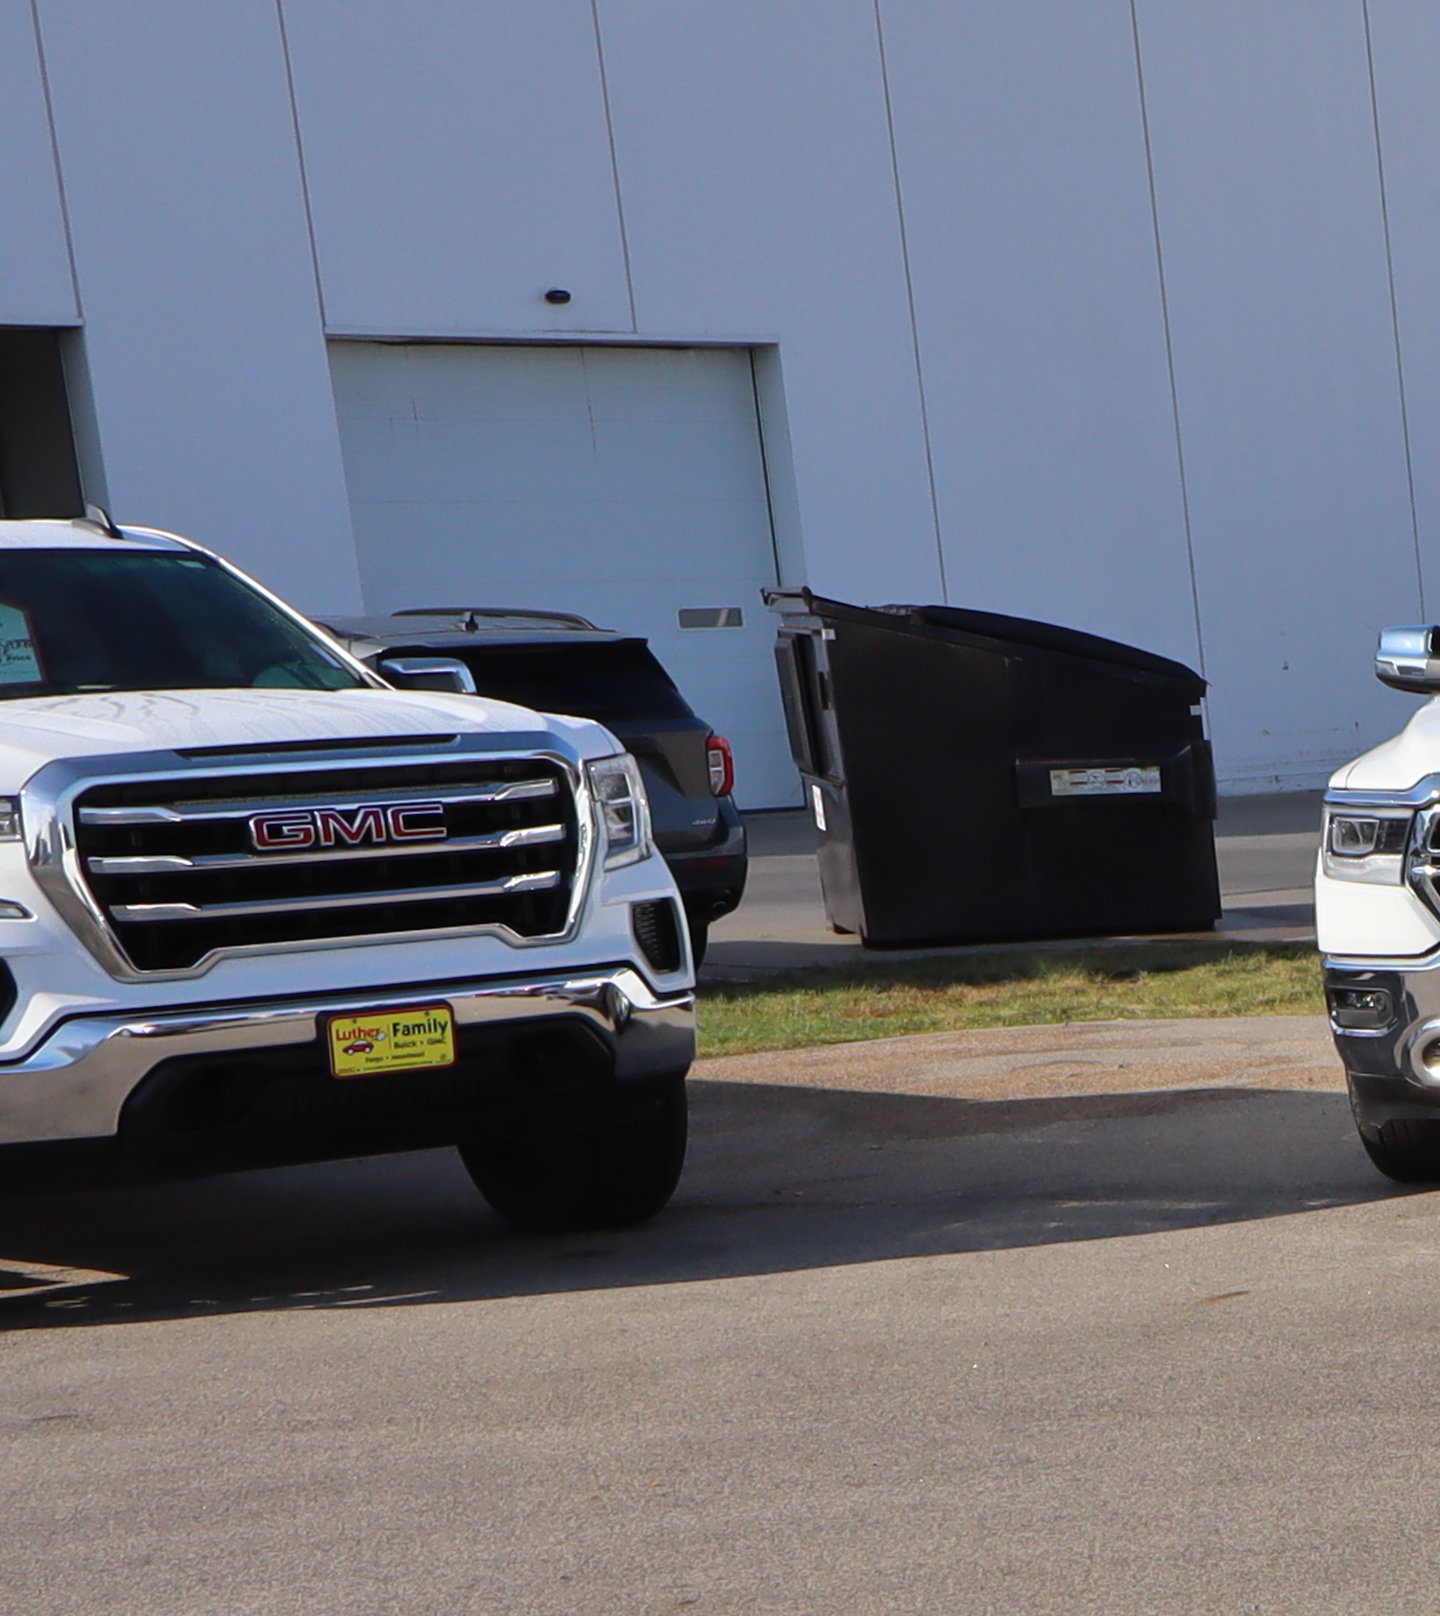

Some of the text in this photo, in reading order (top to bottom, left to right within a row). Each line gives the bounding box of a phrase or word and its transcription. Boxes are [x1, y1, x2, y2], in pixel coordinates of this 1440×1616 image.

[250, 804, 447, 850] GMC
[336, 1018, 448, 1041] Luther Family
